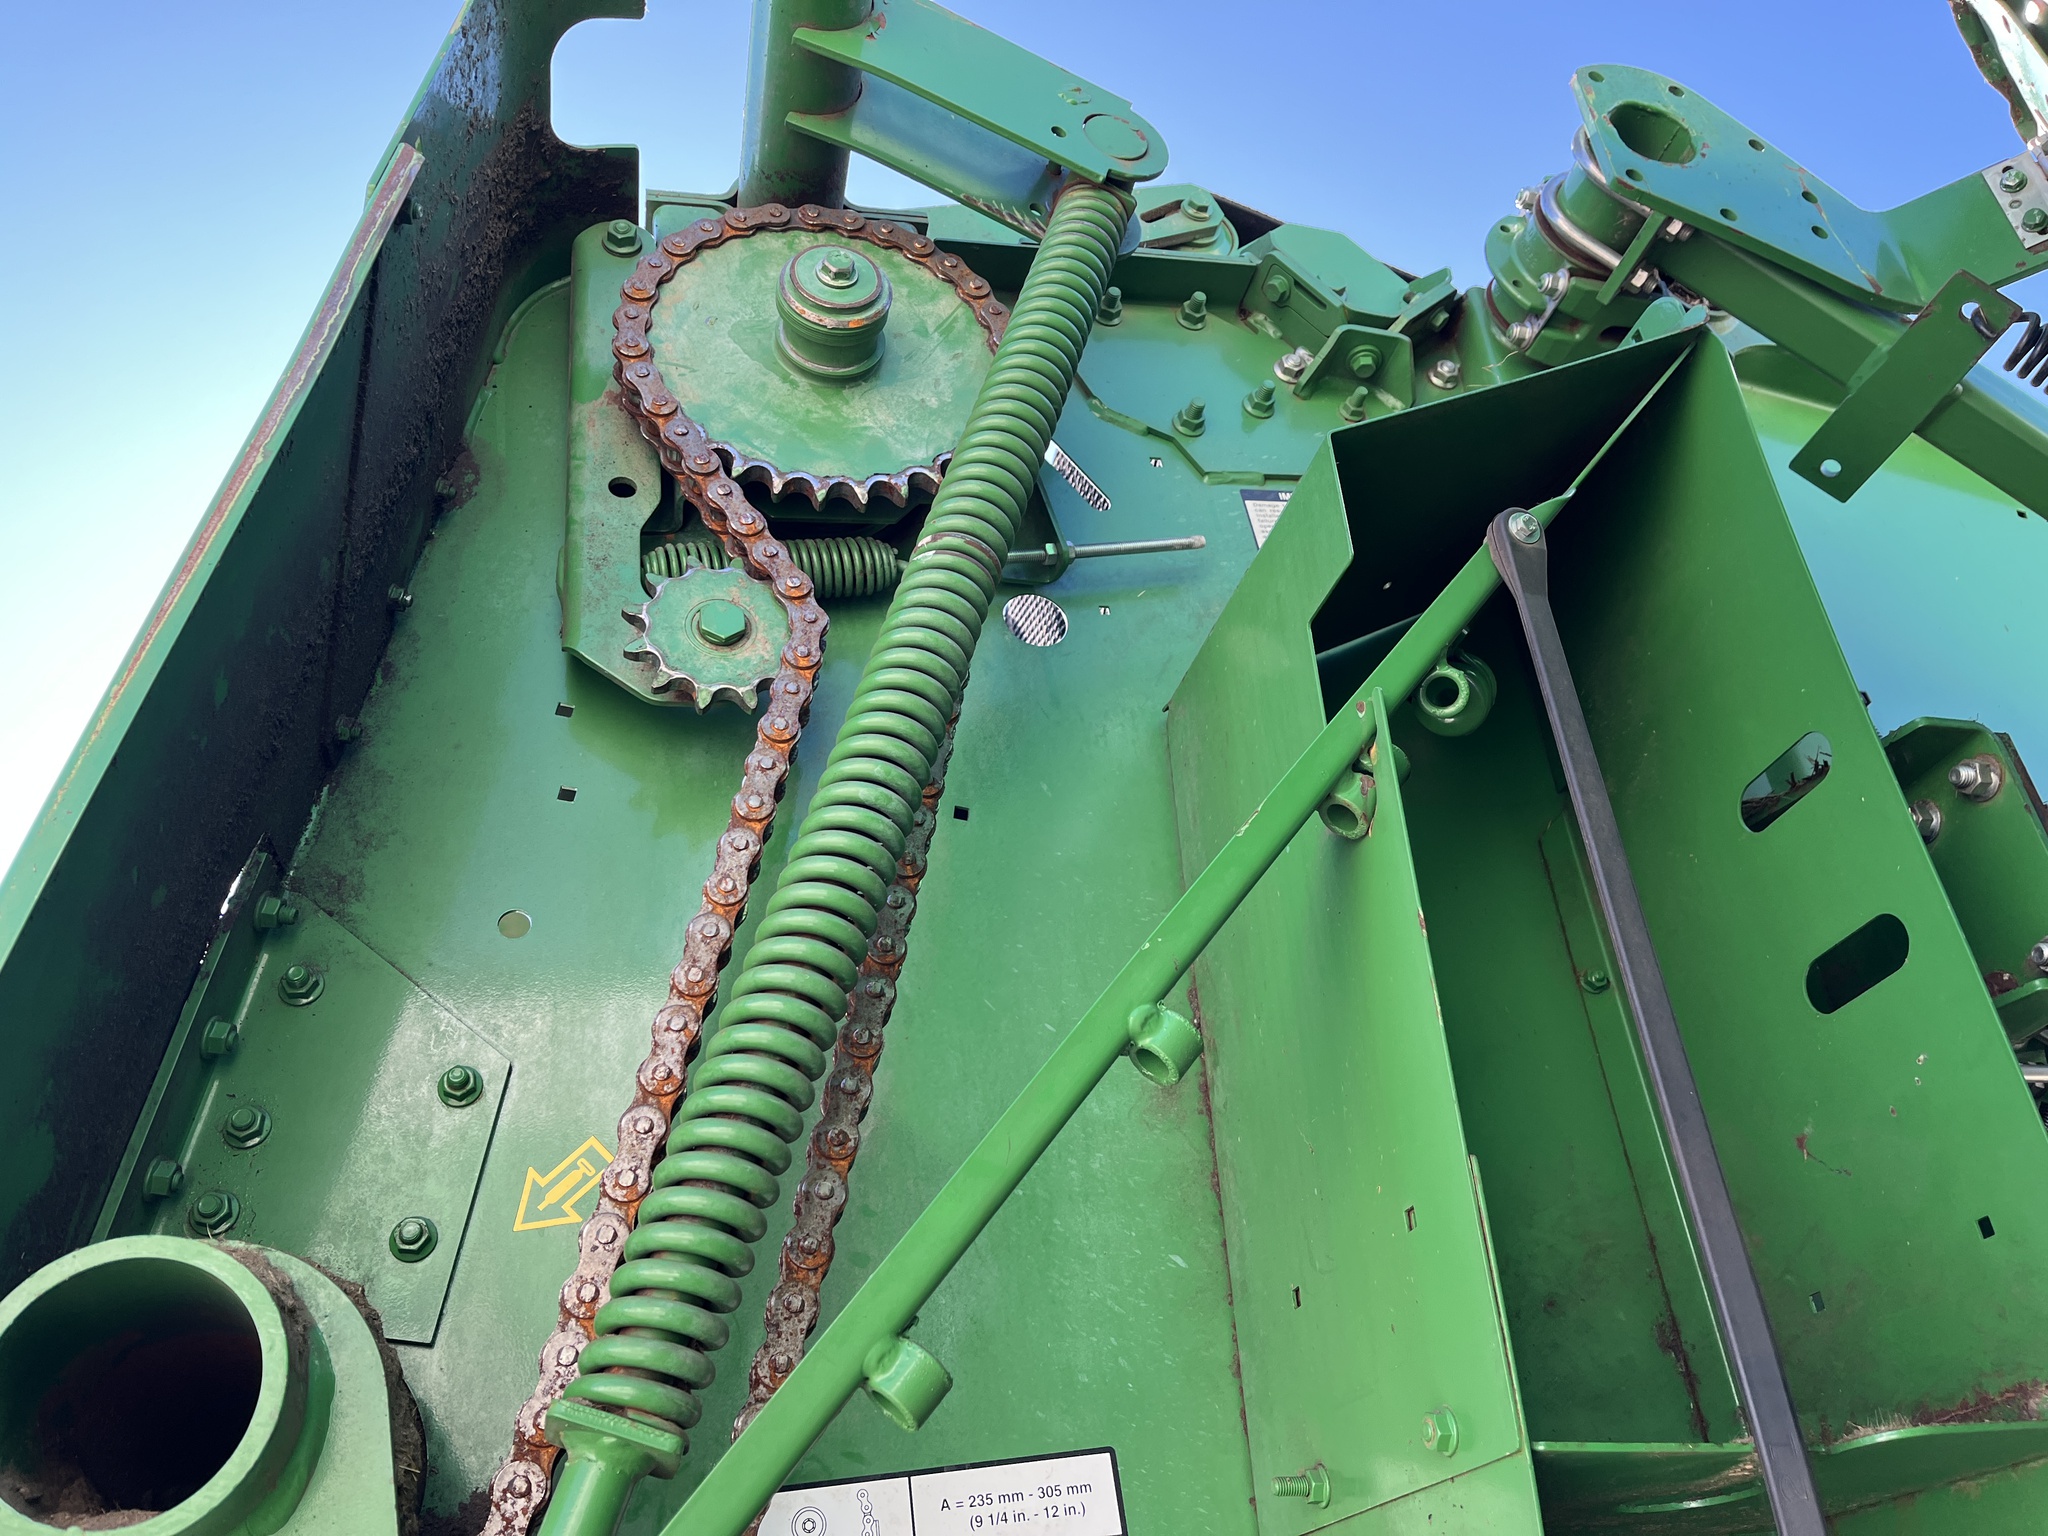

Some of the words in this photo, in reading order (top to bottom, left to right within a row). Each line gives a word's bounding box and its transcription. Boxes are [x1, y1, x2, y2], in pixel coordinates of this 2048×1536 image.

[941, 1499, 951, 1511] A
[968, 1493, 994, 1508] 235
[998, 1491, 1024, 1504] mm
[1037, 1484, 1062, 1499] 305
[1067, 1483, 1092, 1496] mm
[970, 1515, 983, 1531] (9
[988, 1511, 1008, 1526] 1/4
[1013, 1510, 1030, 1523] in.
[1043, 1505, 1059, 1519] 12
[1063, 1502, 1086, 1517] in.)
